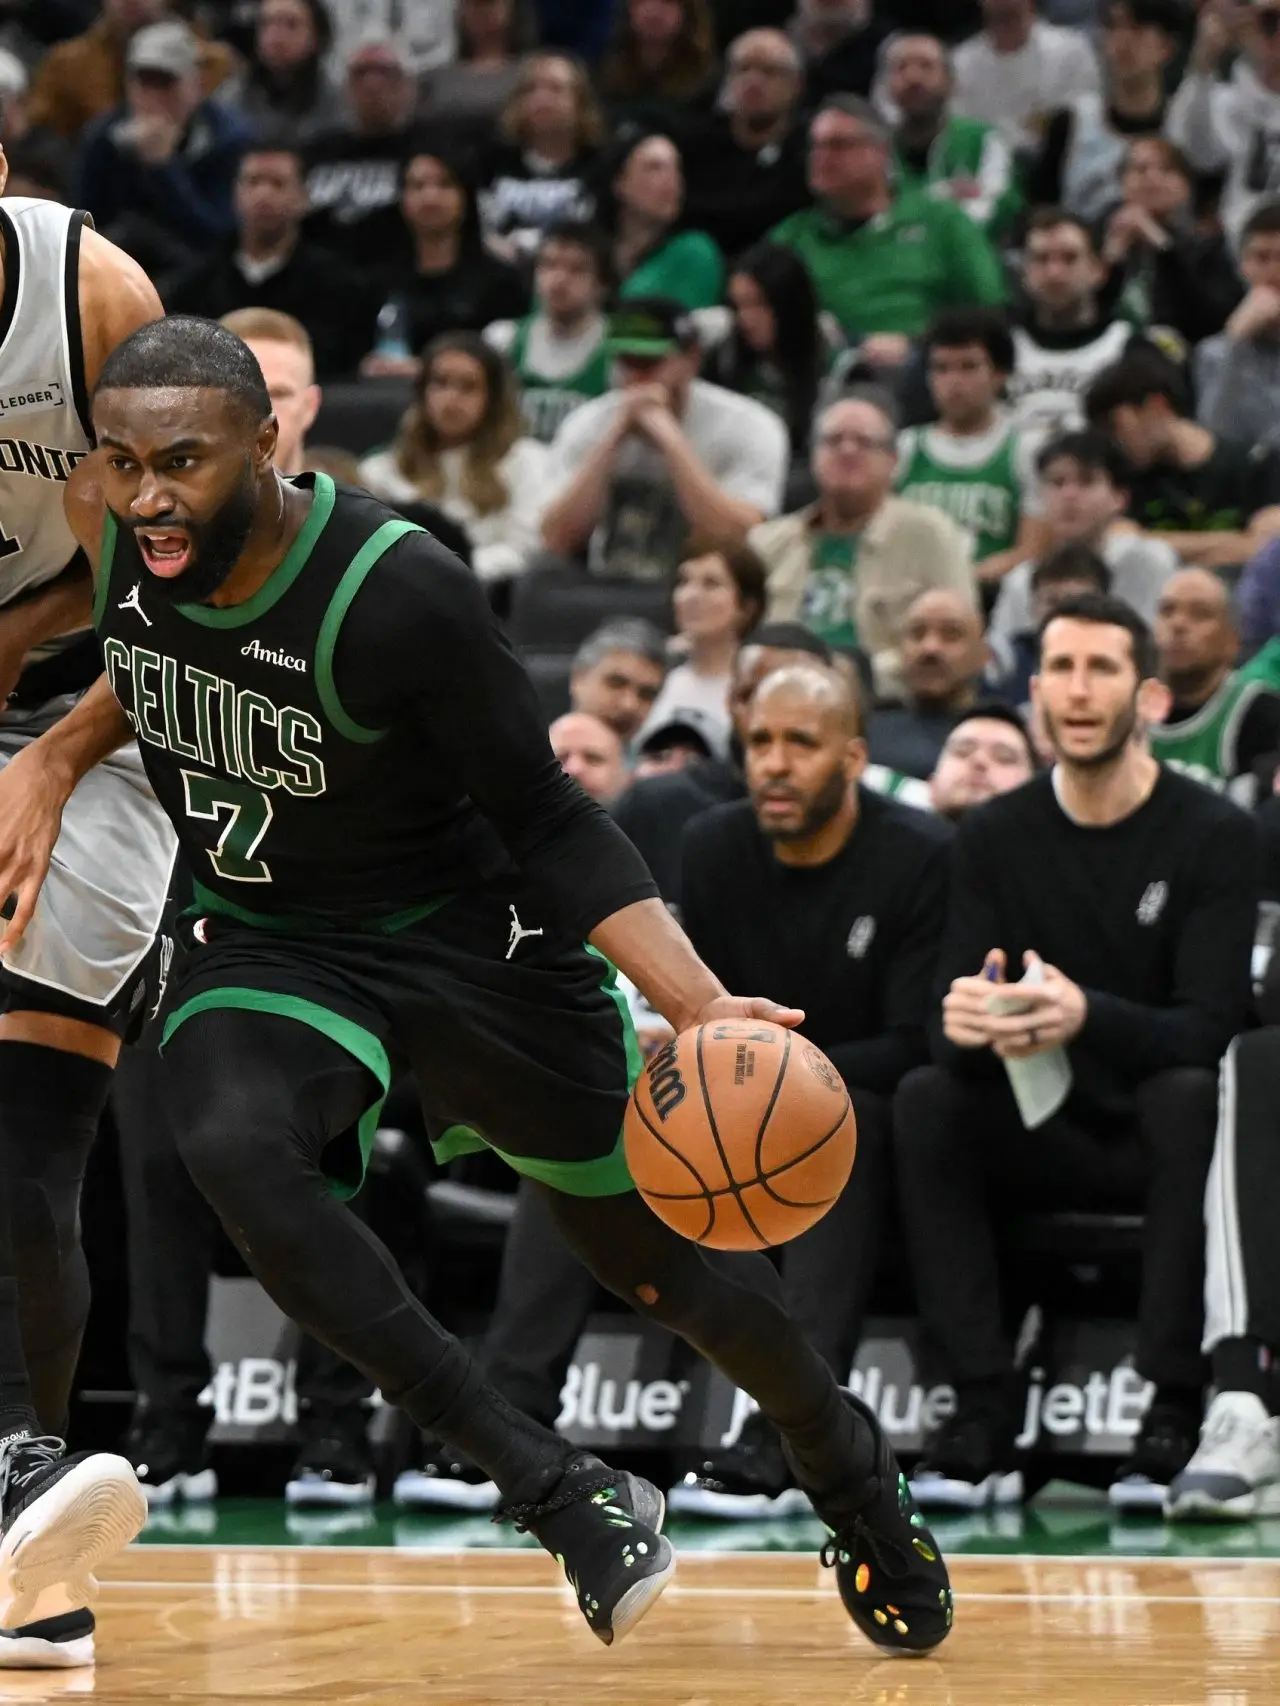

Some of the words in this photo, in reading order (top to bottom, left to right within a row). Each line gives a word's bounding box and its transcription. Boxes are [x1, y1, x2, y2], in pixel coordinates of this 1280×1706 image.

[0, 390, 53, 410] LEDGER
[240, 639, 307, 673] Amica
[104, 636, 326, 797] CELTICS
[180, 768, 273, 882] 7
